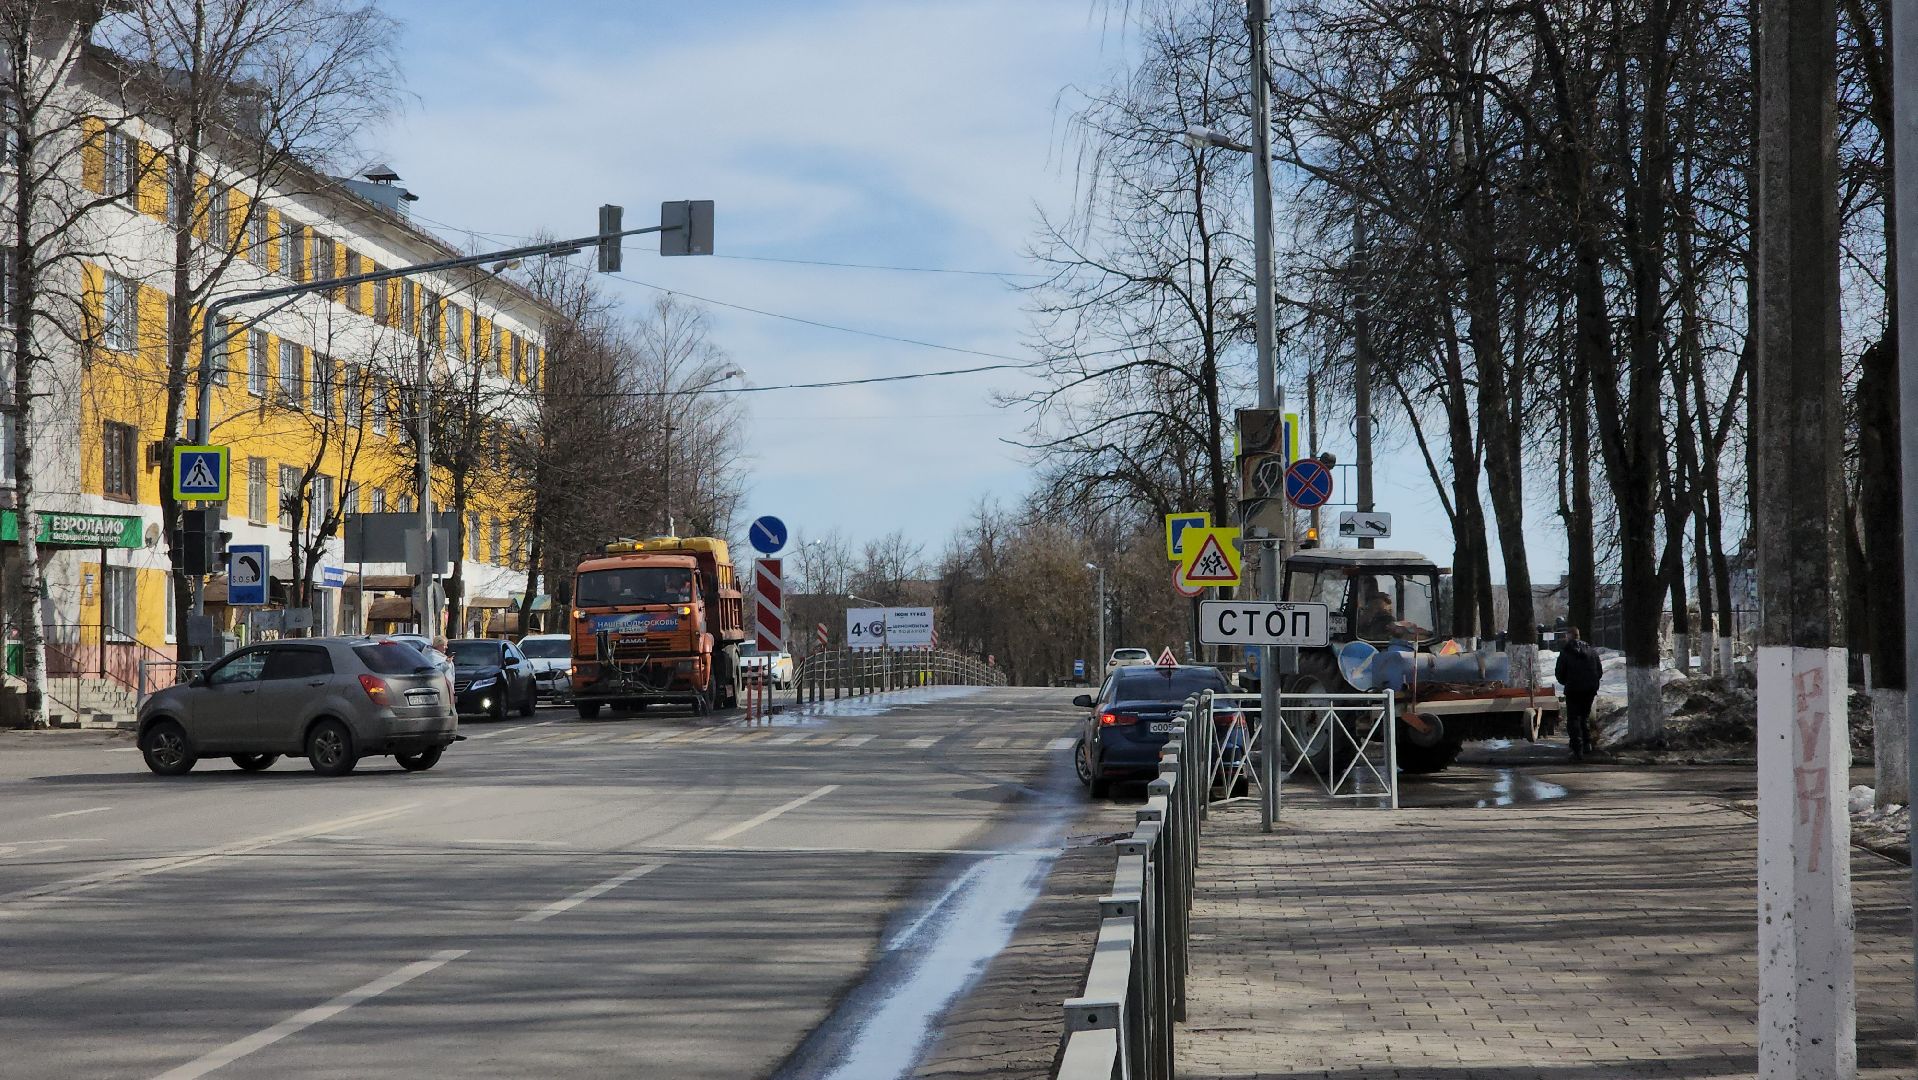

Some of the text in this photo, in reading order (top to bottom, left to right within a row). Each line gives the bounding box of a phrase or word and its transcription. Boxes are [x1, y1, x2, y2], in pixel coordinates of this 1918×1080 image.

[52, 516, 124, 534] ЕВРОЛАЙФ
[851, 622, 863, 637] 4
[1218, 609, 1310, 638] СТОП
